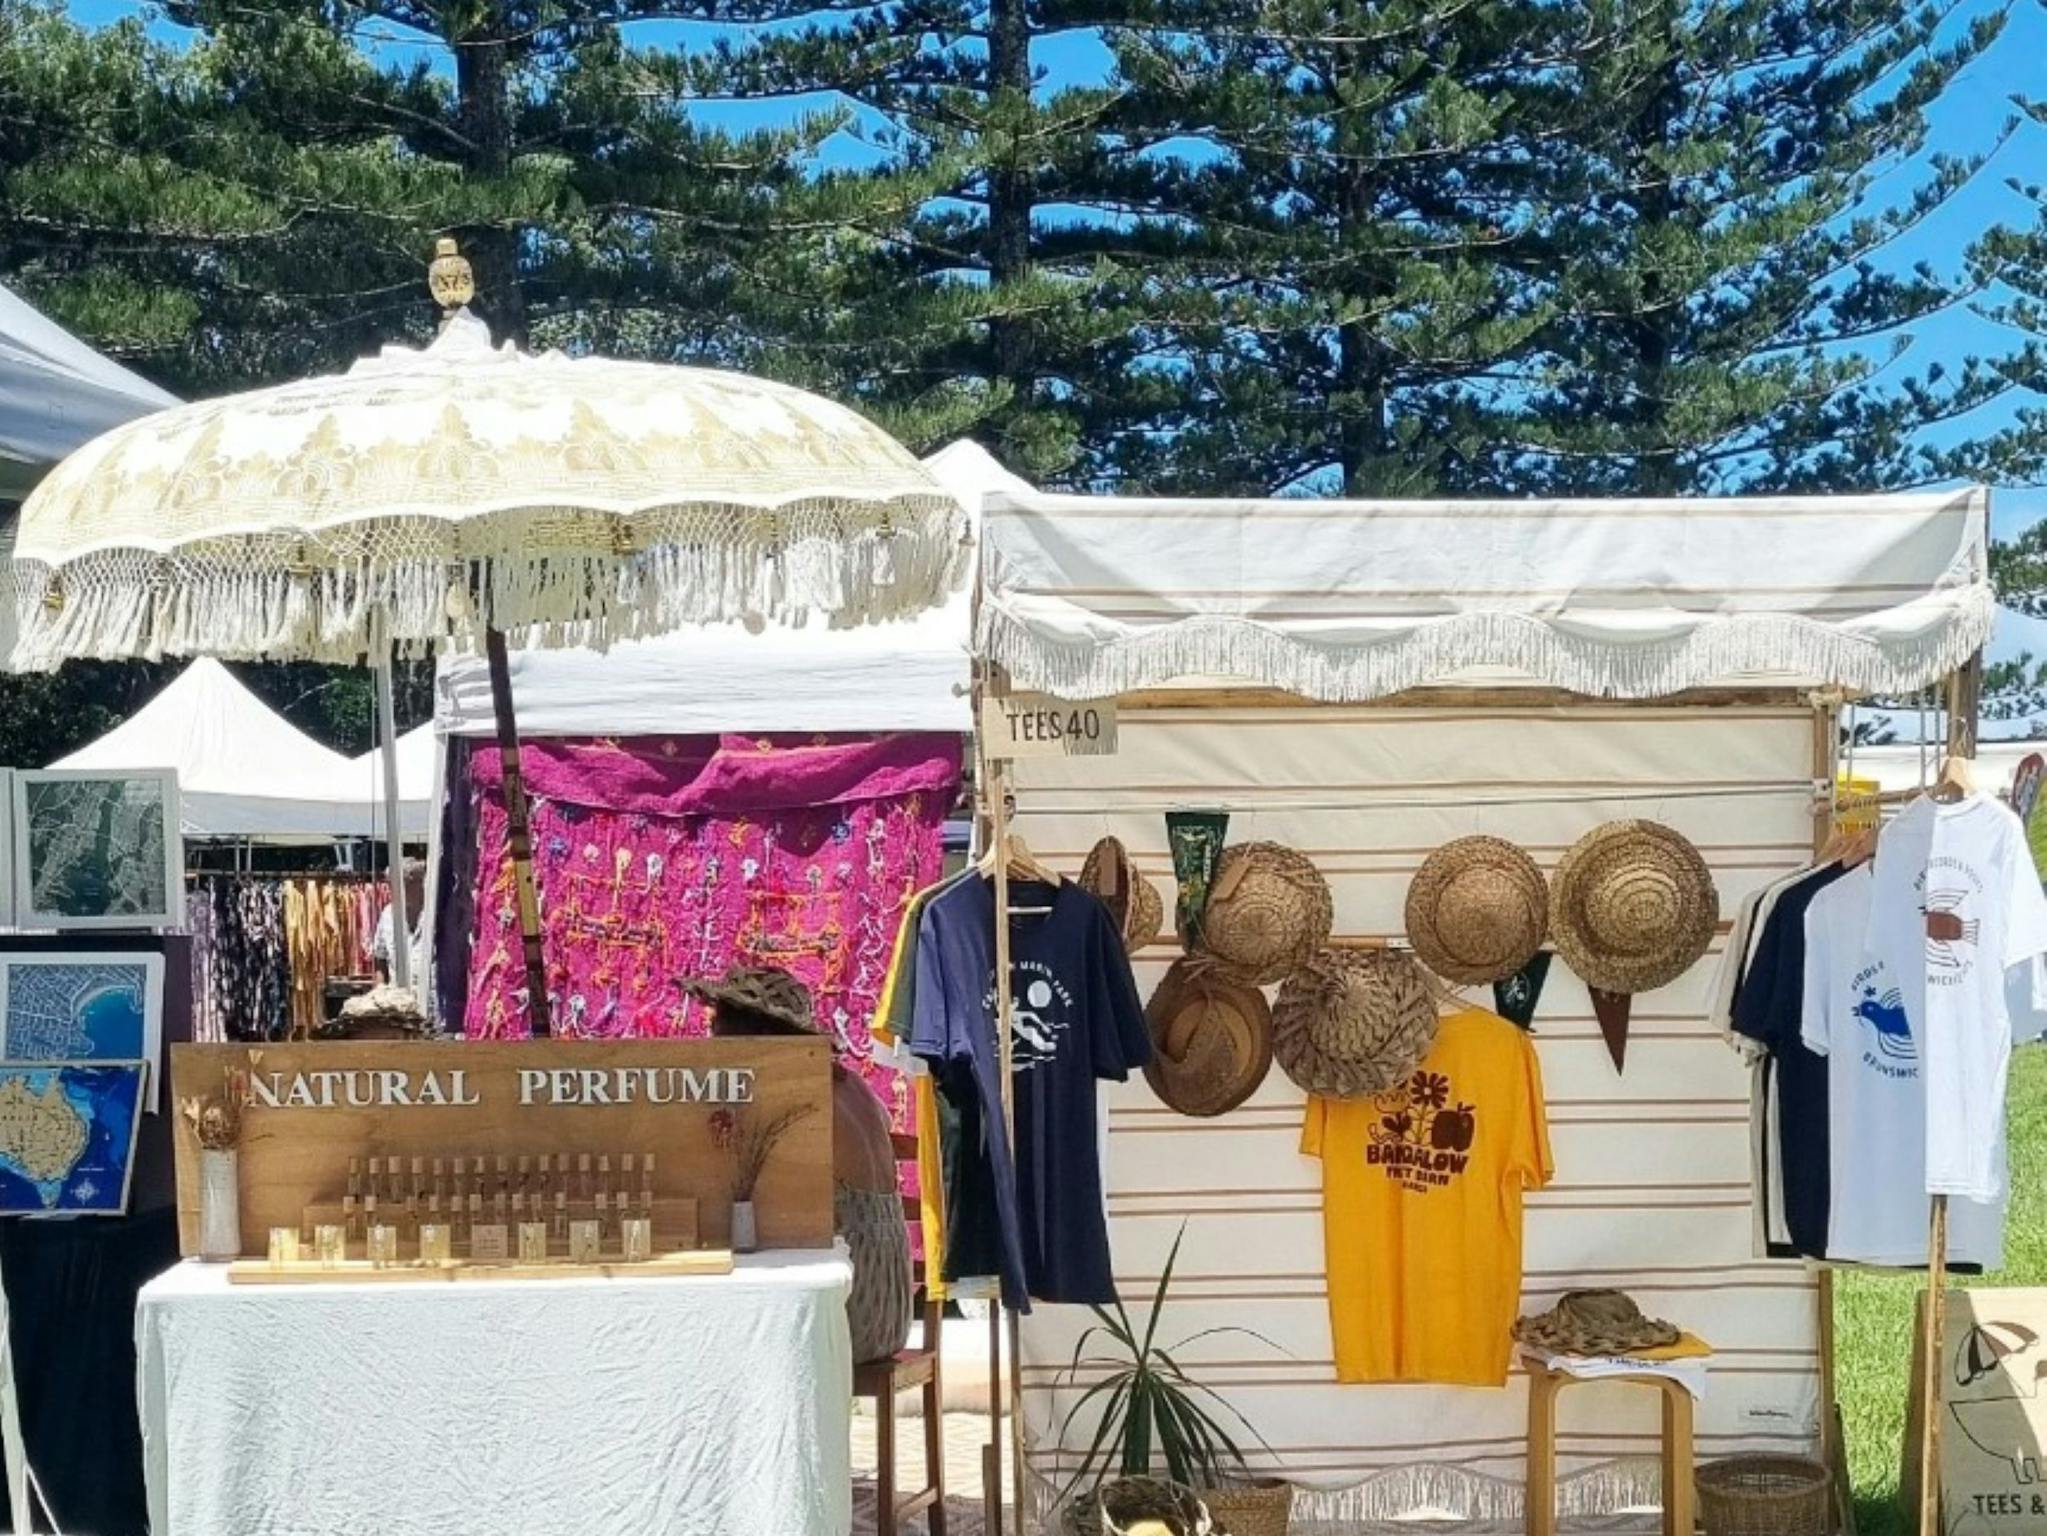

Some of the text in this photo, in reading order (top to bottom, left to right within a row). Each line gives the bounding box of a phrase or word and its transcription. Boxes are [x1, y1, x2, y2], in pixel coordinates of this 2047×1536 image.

[1006, 709, 1100, 742] TEES 40
[249, 1067, 756, 1108] NATURAL PERFUME
[1973, 1493, 2022, 1516] TEES
